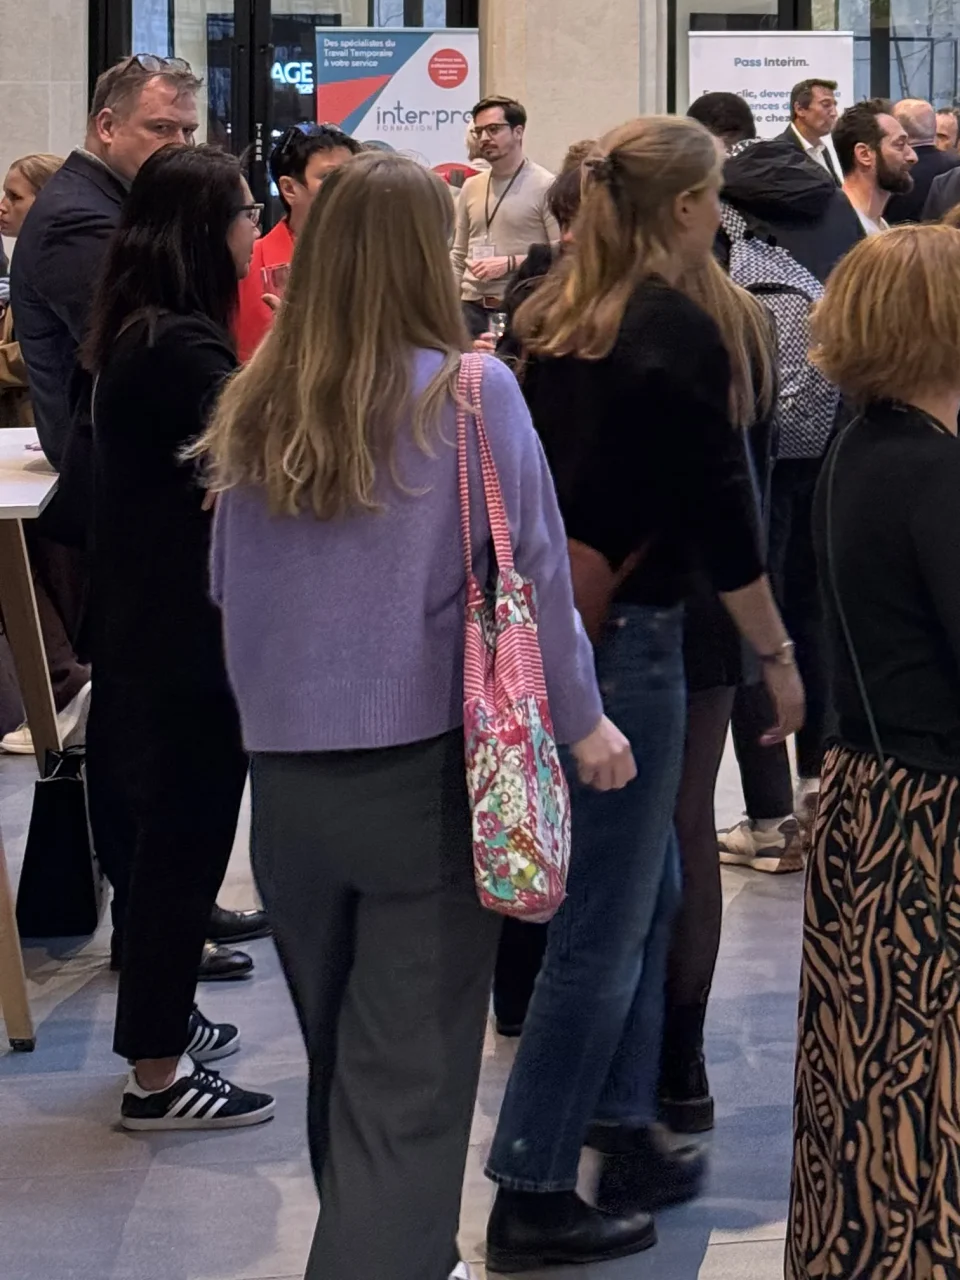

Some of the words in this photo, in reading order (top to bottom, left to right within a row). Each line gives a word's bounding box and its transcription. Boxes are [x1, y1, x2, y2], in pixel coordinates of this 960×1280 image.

[323, 38, 339, 48] Des
[340, 38, 384, 49] spécialistes
[385, 39, 396, 48] du
[323, 48, 349, 58] Travail
[350, 48, 394, 59] Temporaire
[330, 59, 350, 67] votre
[351, 59, 379, 67] service
[734, 57, 762, 68] Pass
[376, 124, 433, 132] FORMATION
